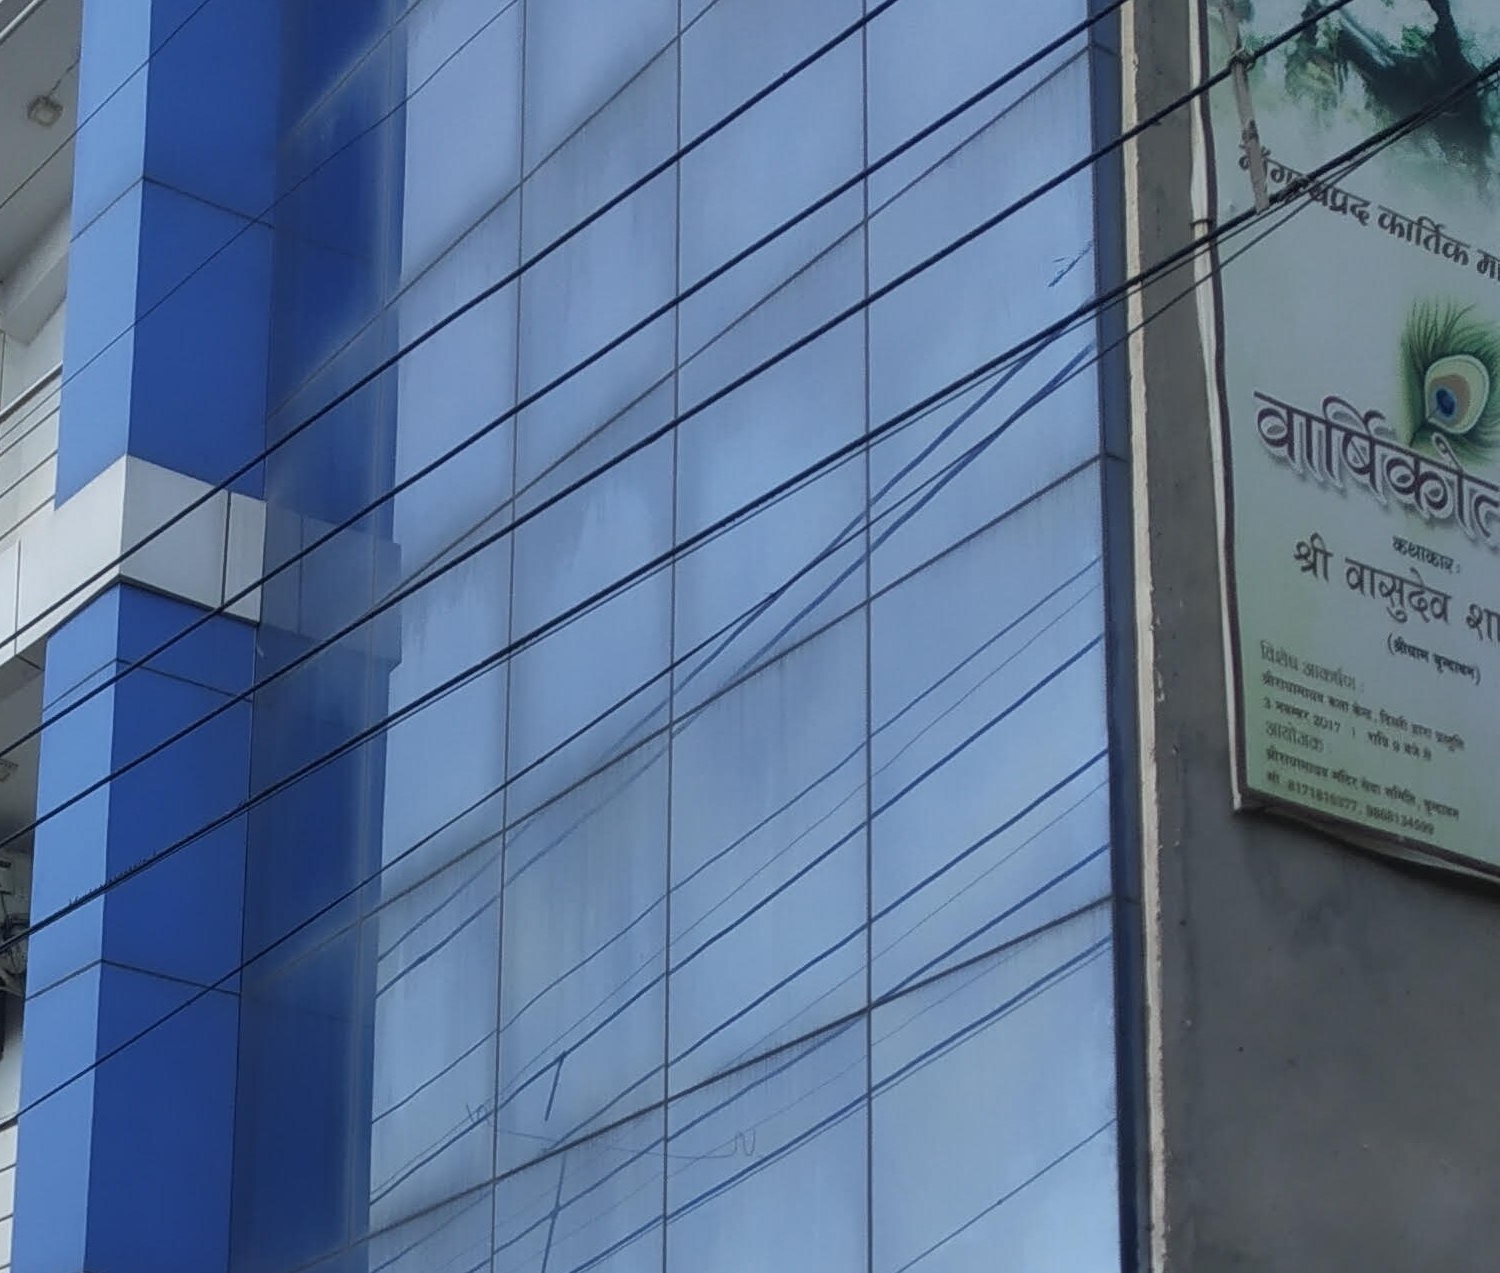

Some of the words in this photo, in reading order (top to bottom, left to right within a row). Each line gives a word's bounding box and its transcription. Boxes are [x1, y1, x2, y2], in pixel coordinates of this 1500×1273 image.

[1378, 204, 1470, 266] कार्तिक
[1294, 533, 1333, 582] श्री
[1345, 557, 1451, 623] वासुदेव
